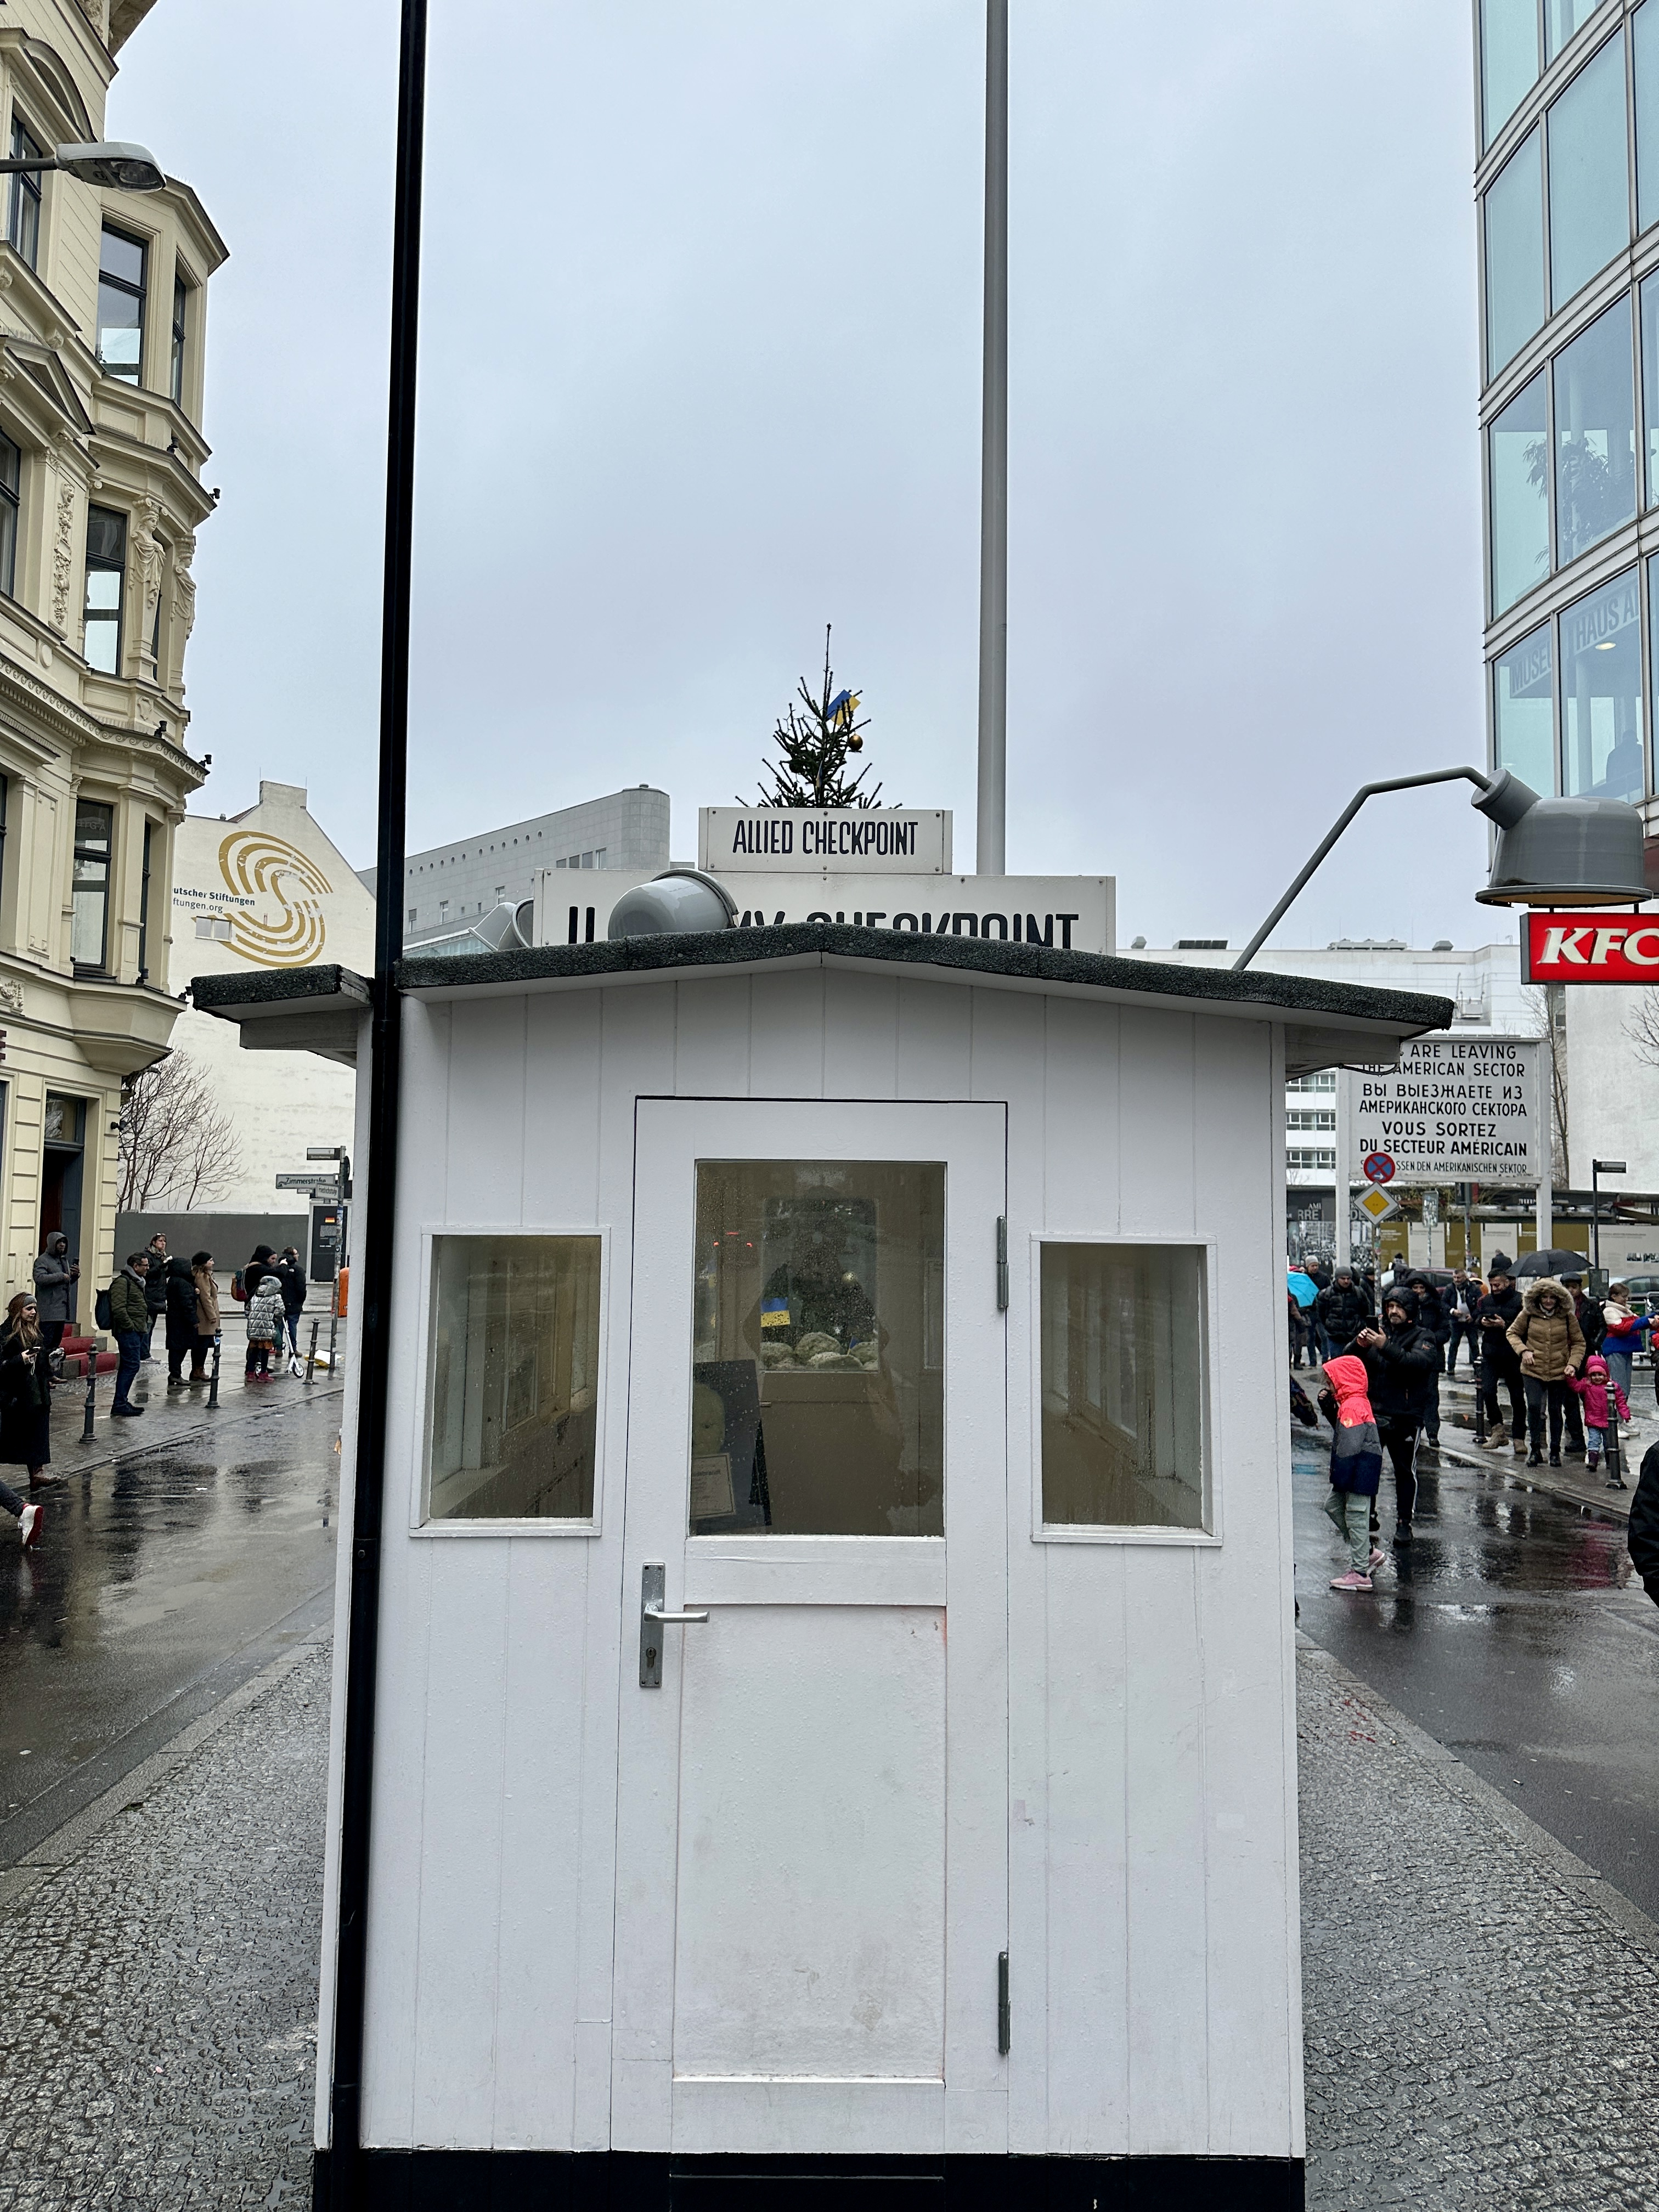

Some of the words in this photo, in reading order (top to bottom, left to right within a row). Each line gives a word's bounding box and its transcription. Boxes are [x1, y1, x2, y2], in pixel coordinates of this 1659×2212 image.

[1576, 597, 1618, 650] HAUS
[732, 820, 793, 854] ALLIED
[803, 821, 918, 855] CHECKPOINT
[173, 887, 207, 899] utscher
[208, 891, 256, 906] Stiftungen
[172, 897, 223, 914] ftungen.org
[1536, 927, 1659, 966] KFC
[1410, 1045, 1441, 1058] ARE
[1452, 1045, 1516, 1059] LEAVING
[1473, 1063, 1525, 1077] SECTOR
[1363, 1083, 1386, 1097] ВЫ
[1397, 1084, 1492, 1099] ВЫЕЗЖАЕТЕ
[1503, 1086, 1522, 1099] ИЗ
[1359, 1100, 1467, 1115] АМЕРИКАНСКОГО
[1472, 1103, 1527, 1117] СЕКТОРА
[1381, 1121, 1426, 1136] VOUS
[1435, 1122, 1497, 1137] SORTEZ
[1360, 1139, 1378, 1153] DU
[1383, 1139, 1445, 1154] SECTEUR
[1417, 1161, 1431, 1172] DEN
[1434, 1161, 1498, 1173] AMERIKANISCHEN
[1499, 1163, 1527, 1174] SEKTOR
